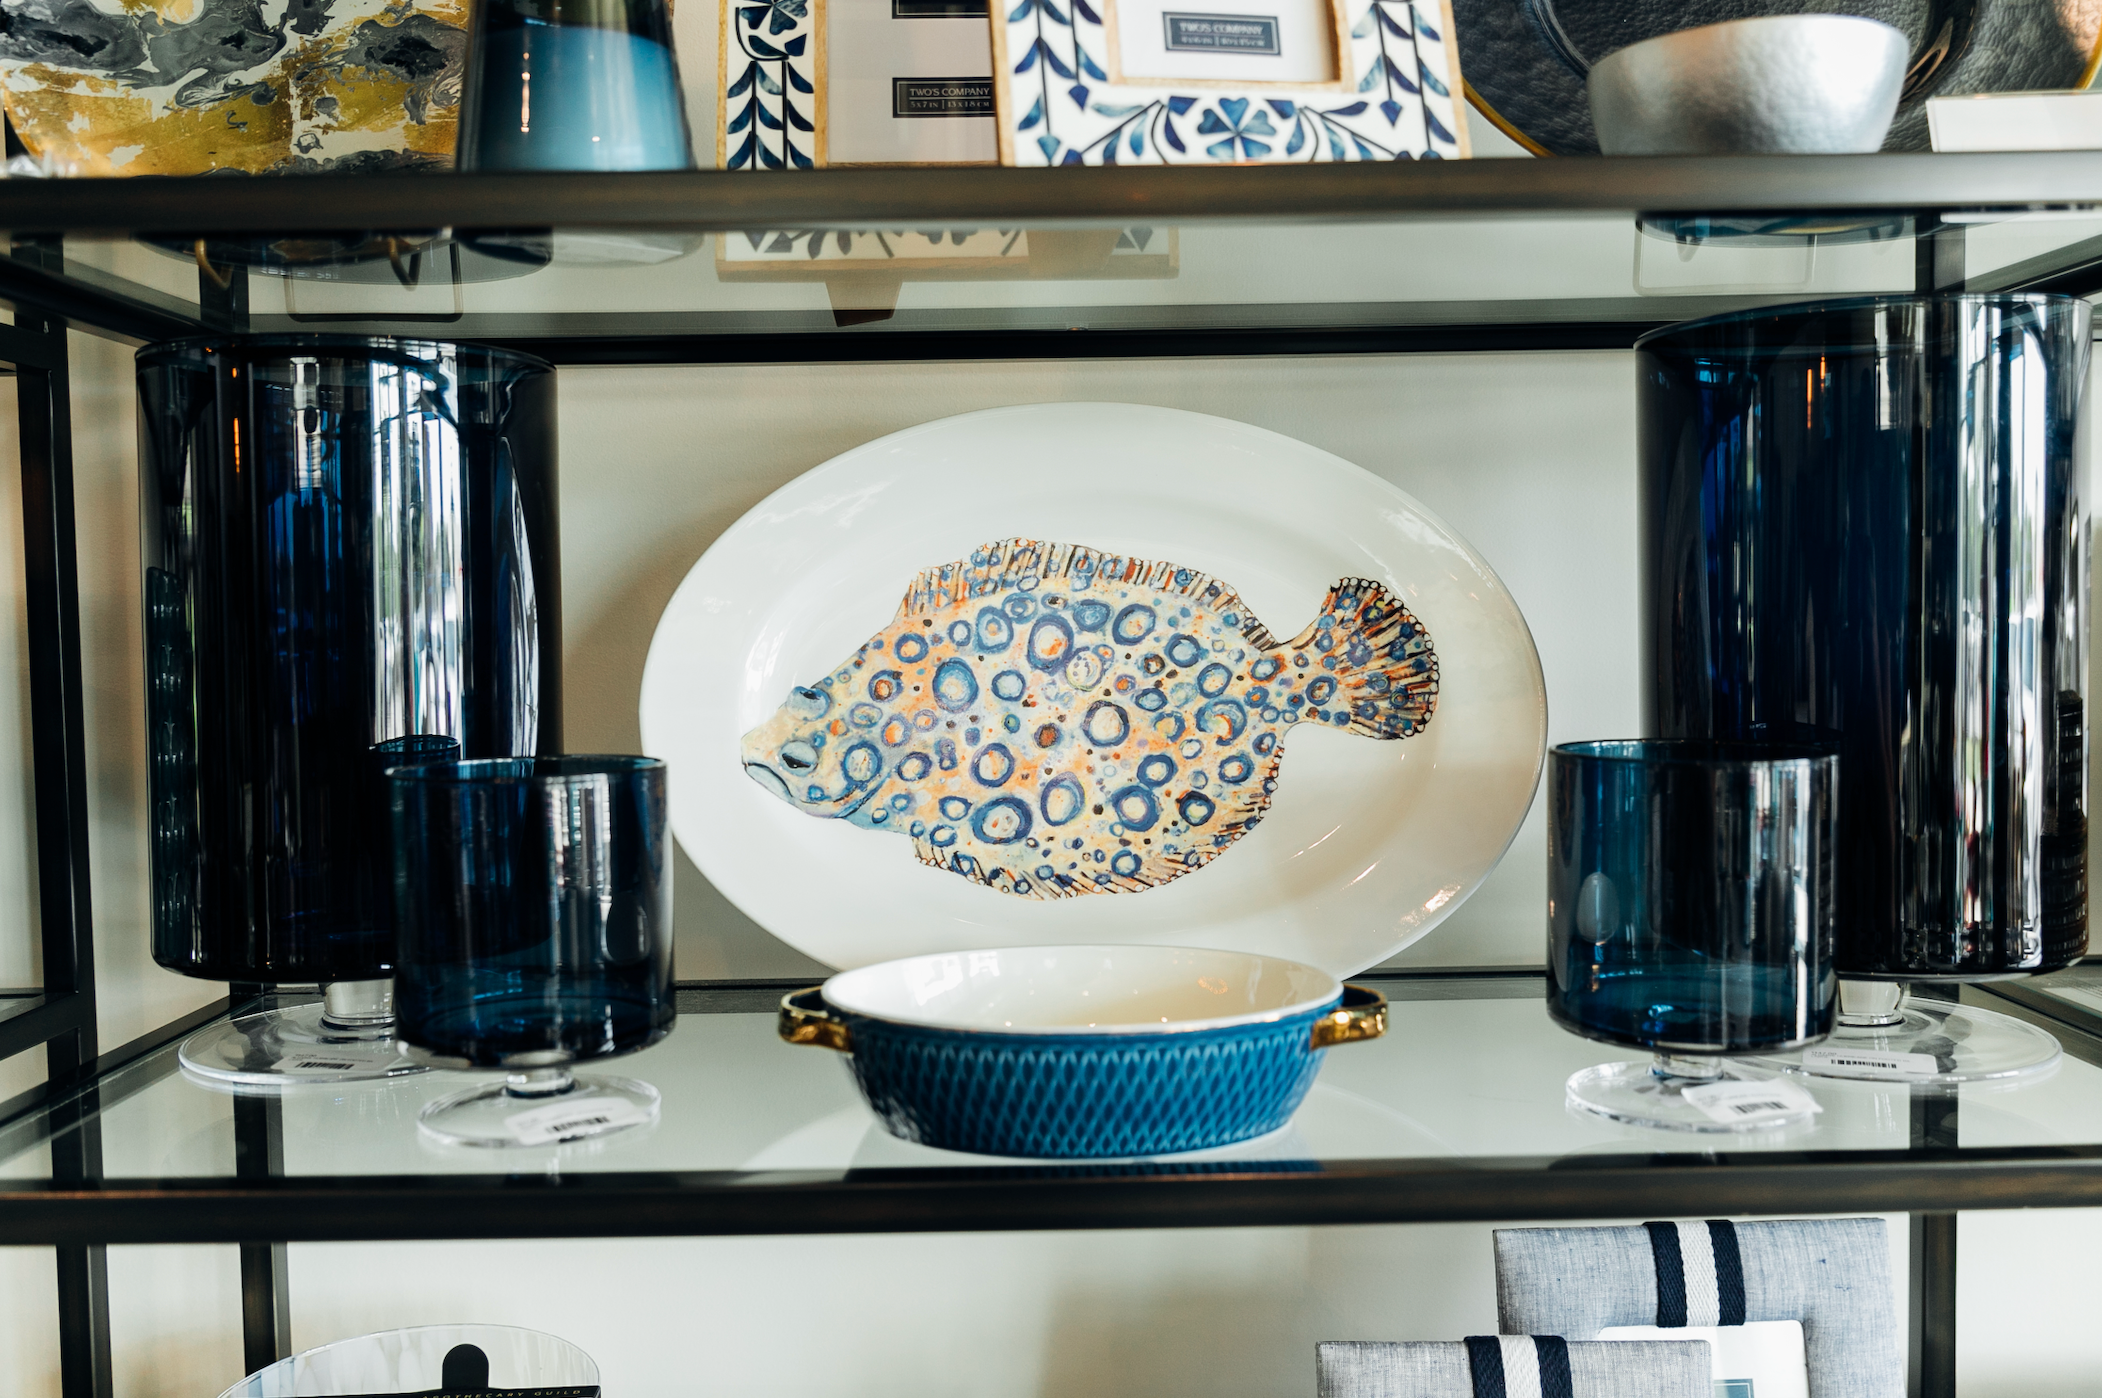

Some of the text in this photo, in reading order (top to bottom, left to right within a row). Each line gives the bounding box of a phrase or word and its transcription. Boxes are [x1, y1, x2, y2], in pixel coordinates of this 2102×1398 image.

[1213, 24, 1263, 34] COMPANY
[910, 87, 990, 96] TWO'S COMPANY
